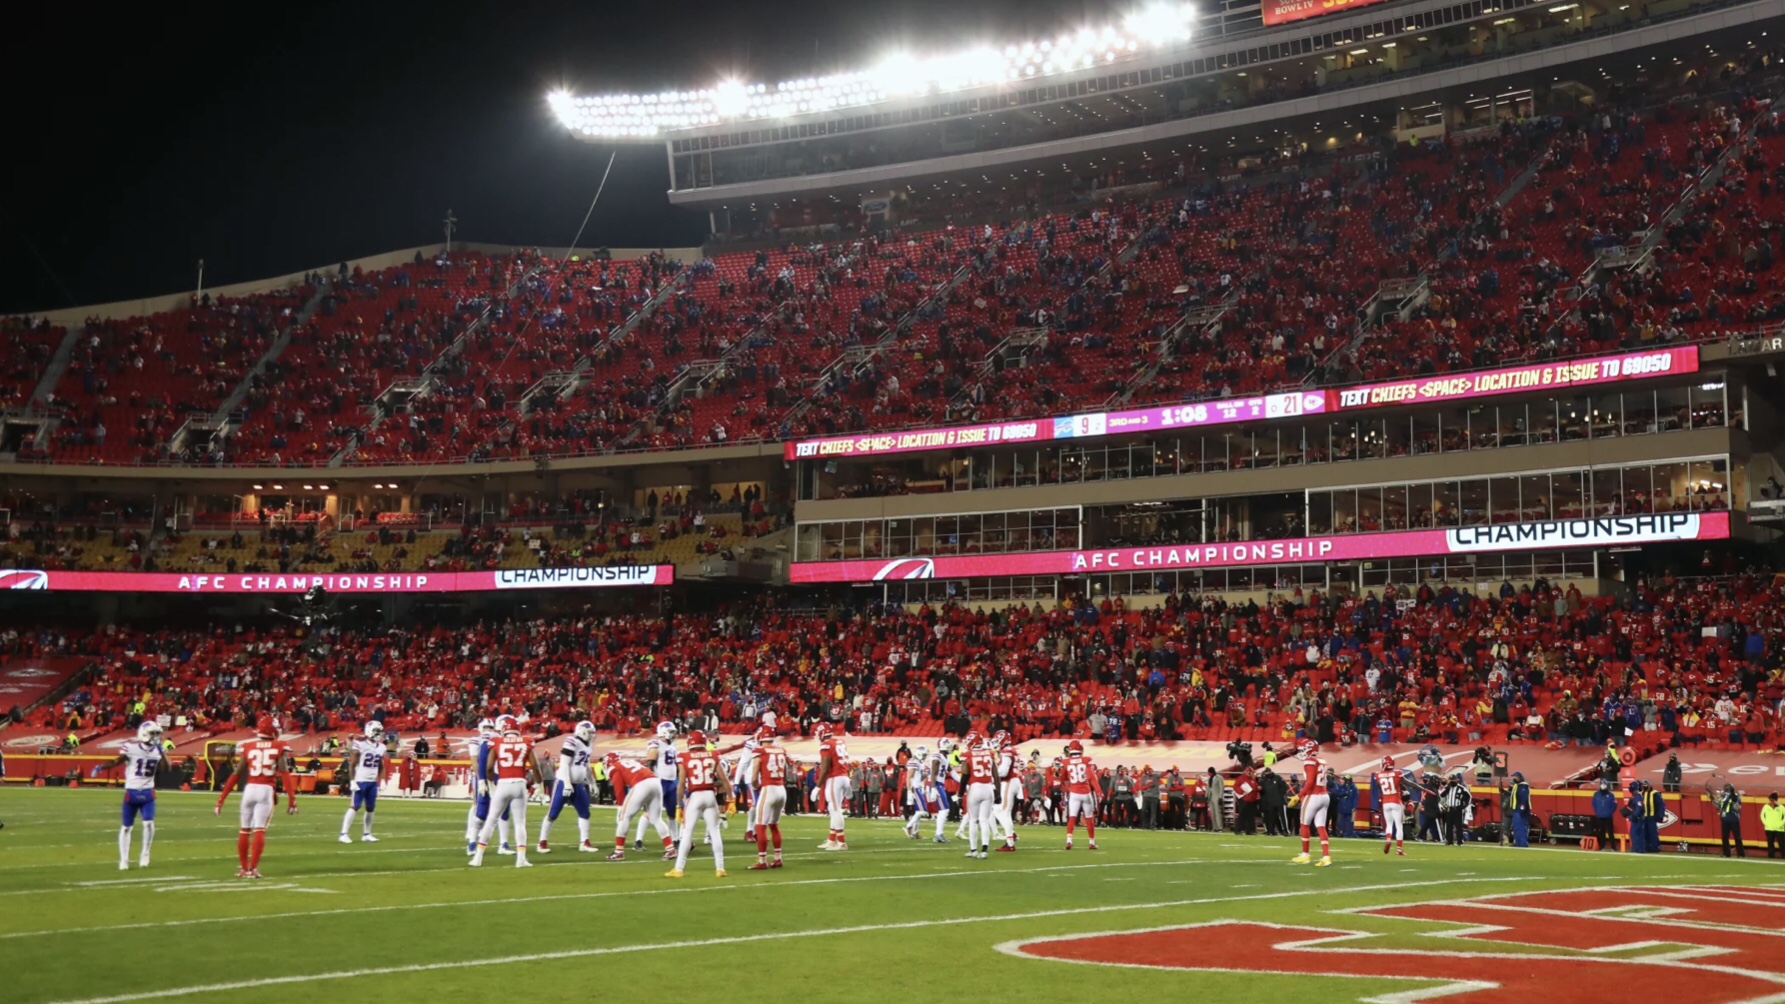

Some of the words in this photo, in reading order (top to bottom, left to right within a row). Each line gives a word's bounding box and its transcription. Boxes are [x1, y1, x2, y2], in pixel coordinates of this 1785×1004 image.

[1275, 2, 1302, 15] BOWL
[1303, 1, 1313, 9] IV
[1340, 388, 1371, 407] TEXT
[1371, 384, 1416, 403] CHIEFS
[1419, 380, 1472, 399] <SPACE>
[1474, 371, 1540, 392] LOCATION
[1543, 369, 1552, 385] &
[1555, 363, 1599, 383] ISSUE
[1602, 360, 1618, 378] TO
[1622, 353, 1672, 376] 69050
[1223, 408, 1237, 419] 12
[1251, 406, 1260, 416] 2
[1283, 396, 1297, 414] 21
[1109, 418, 1127, 427] 3RD
[1141, 415, 1148, 424] 3
[1161, 405, 1208, 424] 1:08
[1081, 417, 1089, 434] 9
[796, 441, 819, 456] TEXT
[819, 439, 854, 454] CHIEFS
[855, 438, 896, 452] <SPACE>
[897, 431, 945, 448] LOCATION
[947, 430, 955, 444] &
[956, 428, 987, 444] ISSUE
[988, 426, 1000, 440] TO
[1455, 513, 1689, 544] CHAMPIONSHIP
[1074, 551, 1119, 569] AFC
[1133, 540, 1333, 566] CHAMPIONSHIP
[178, 576, 226, 589] AFC
[240, 575, 428, 589] CHAMPIONSHIP
[501, 565, 650, 583] CHAMPIONSHIP
[1720, 704, 1729, 712] 15
[247, 749, 279, 777] 35
[363, 753, 382, 768] 22
[499, 743, 528, 767] 57
[1495, 753, 1506, 768] 3
[134, 758, 158, 777] 15
[687, 758, 716, 785] 32
[971, 756, 993, 777] 53
[1066, 763, 1088, 784] 38
[1380, 777, 1397, 795] 21
[1583, 837, 1595, 850] 10
